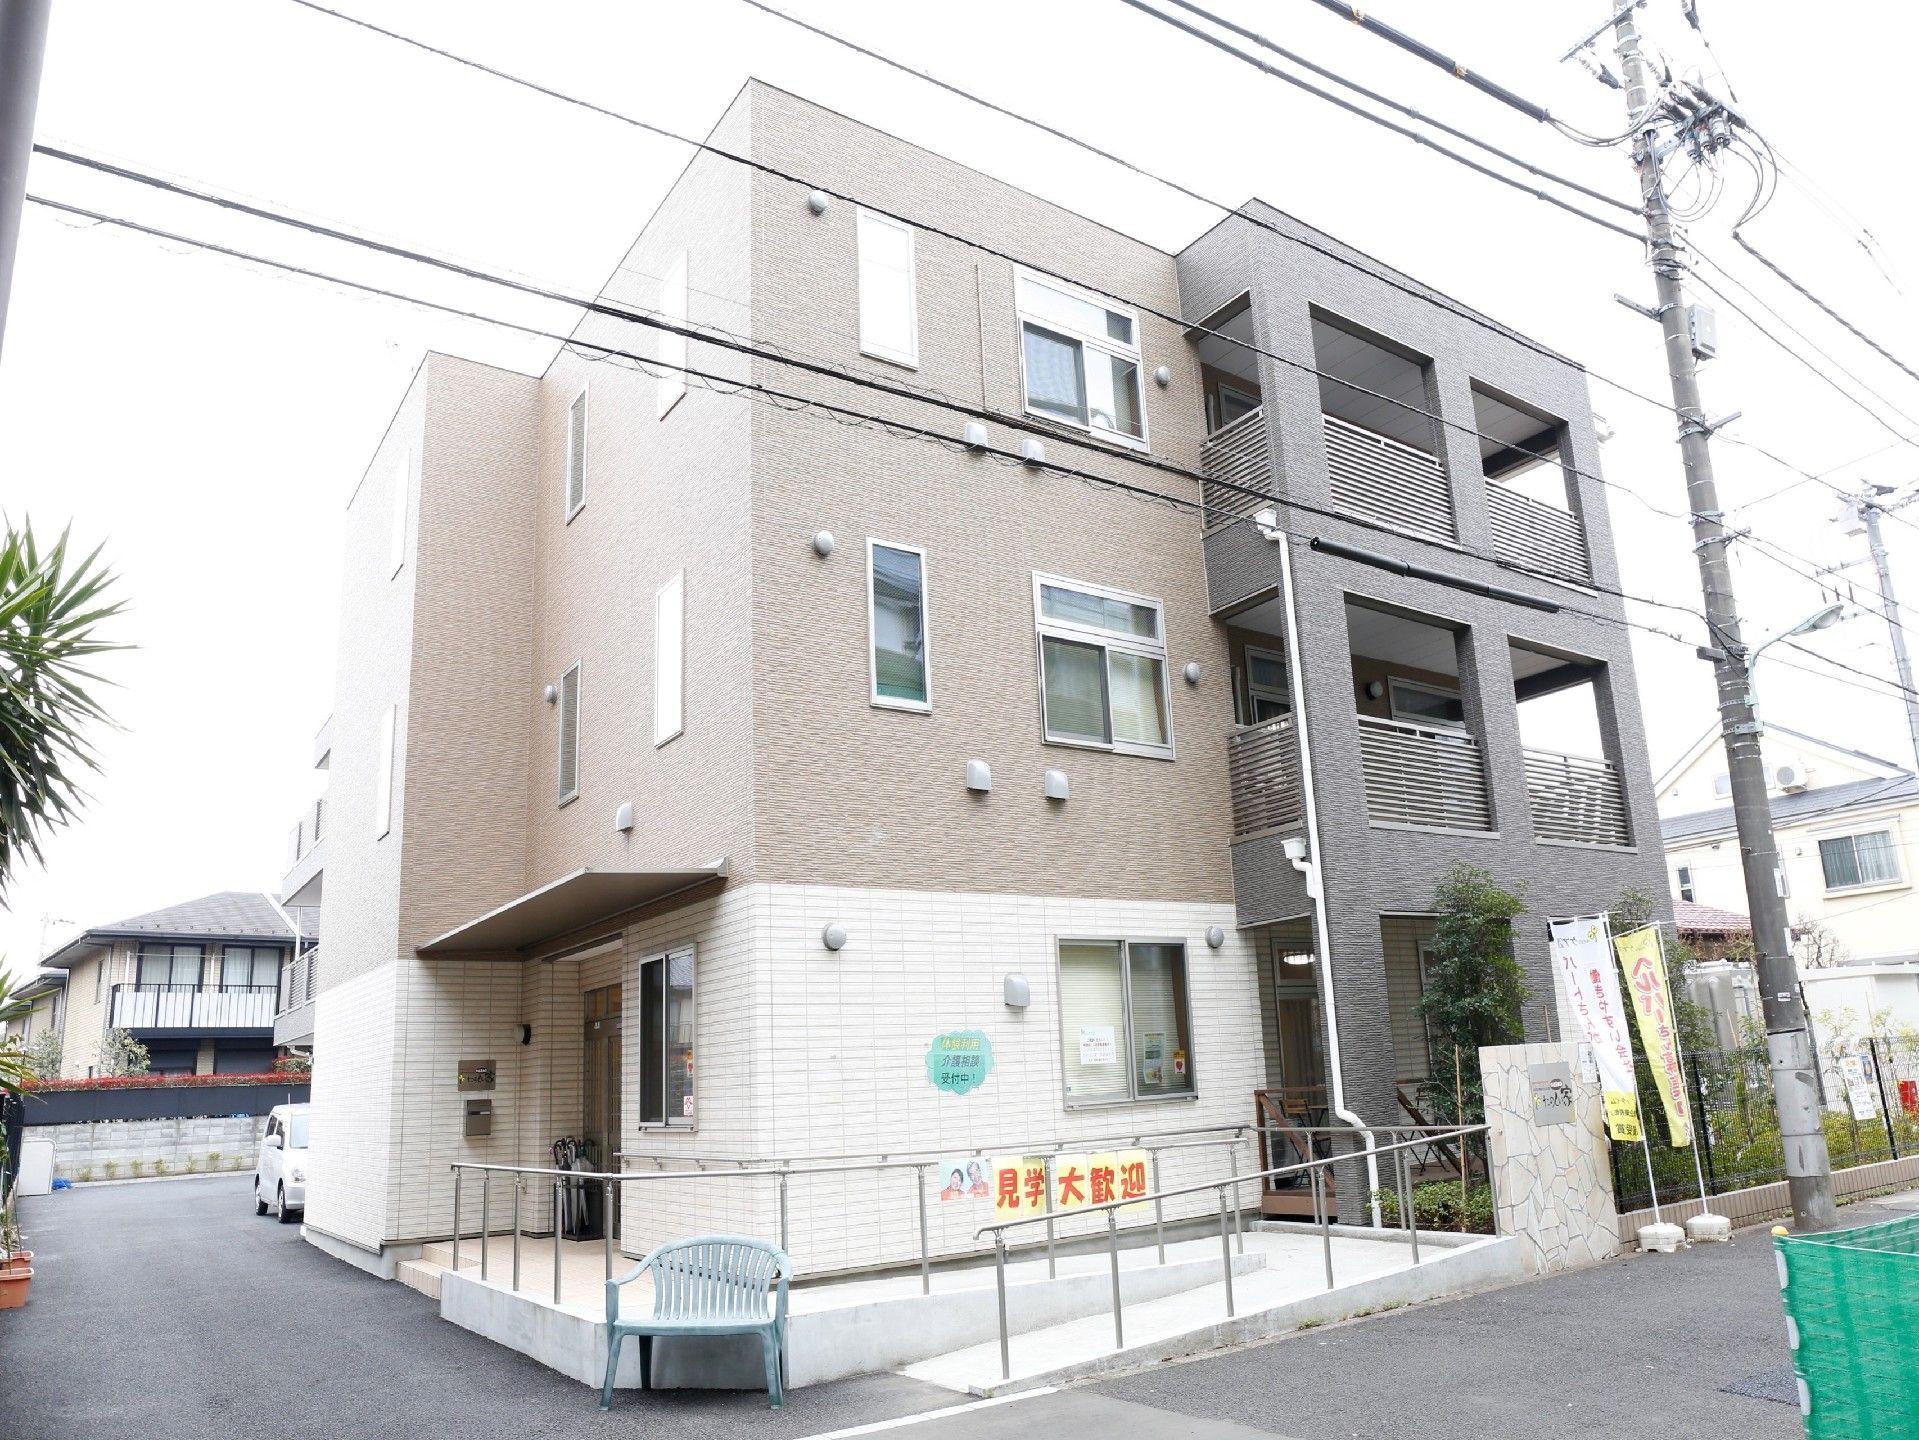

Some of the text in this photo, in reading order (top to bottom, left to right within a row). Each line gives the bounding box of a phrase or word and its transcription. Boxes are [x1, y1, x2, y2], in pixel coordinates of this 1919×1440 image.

[941, 1055, 980, 1067] 介護相談
[996, 1161, 1147, 1209] 見学大歓迎
